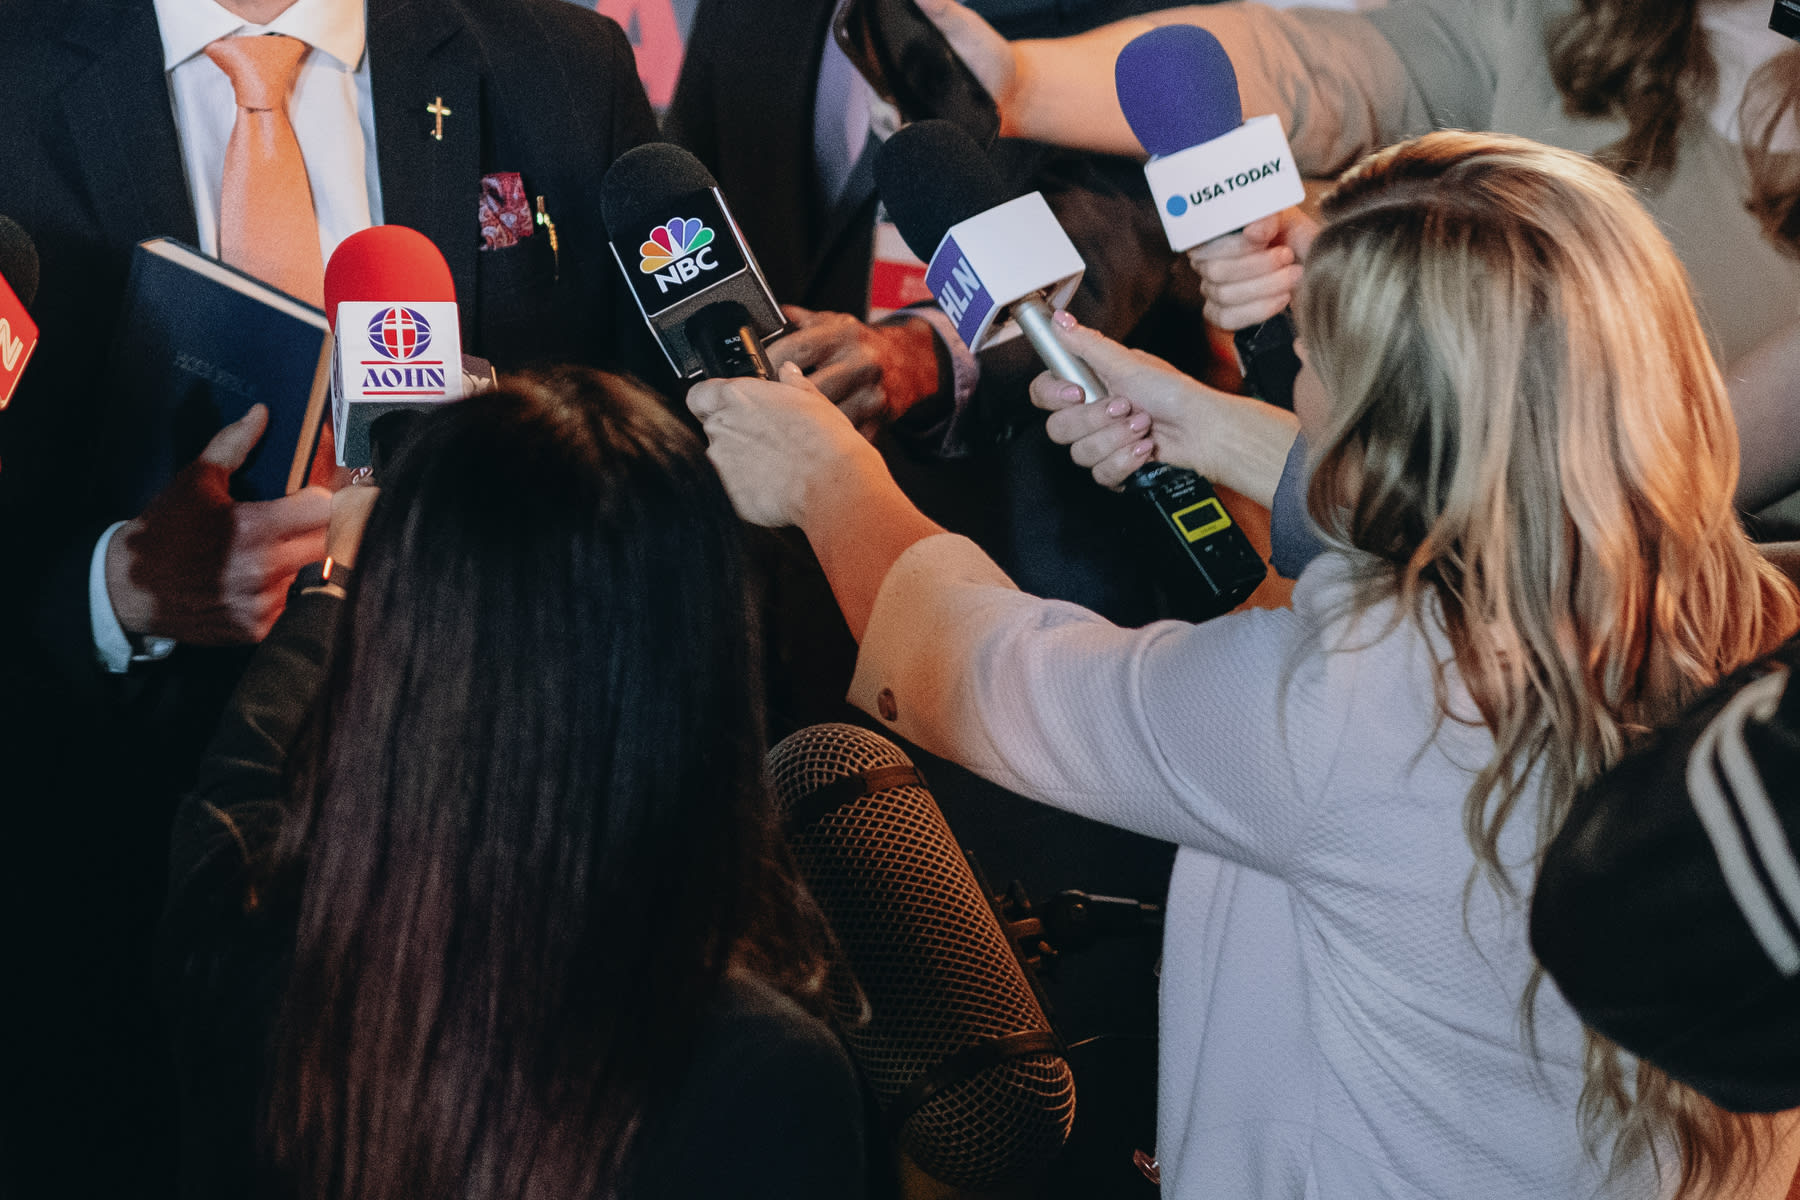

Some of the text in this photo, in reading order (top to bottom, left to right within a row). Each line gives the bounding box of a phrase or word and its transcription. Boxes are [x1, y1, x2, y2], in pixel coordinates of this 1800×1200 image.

[1190, 157, 1281, 206] USA TODAY
[654, 247, 719, 294] NBC
[938, 256, 981, 329] HLN
[362, 368, 446, 388] AOHN
